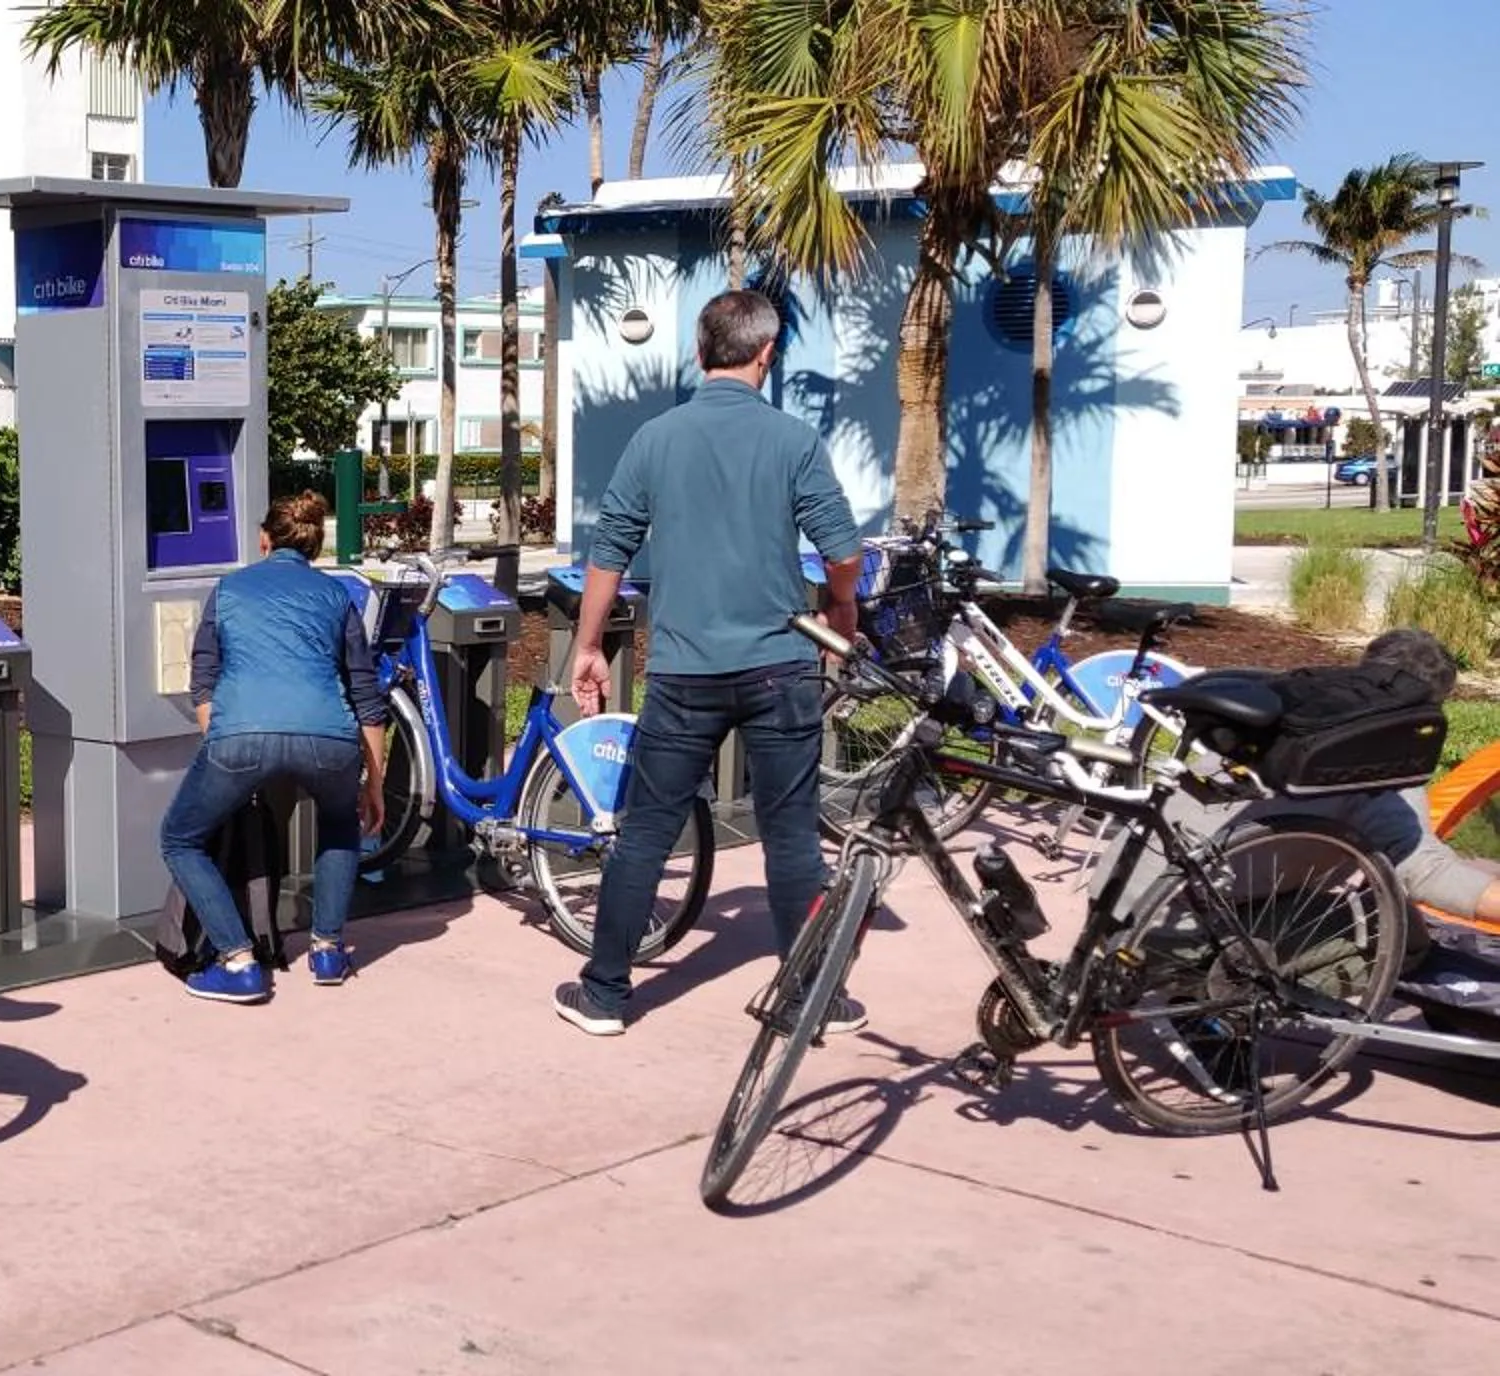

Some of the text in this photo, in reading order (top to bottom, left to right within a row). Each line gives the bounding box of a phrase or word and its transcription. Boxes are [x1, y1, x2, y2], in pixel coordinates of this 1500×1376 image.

[33, 275, 87, 300] citi bike
[593, 742, 617, 762] citi
